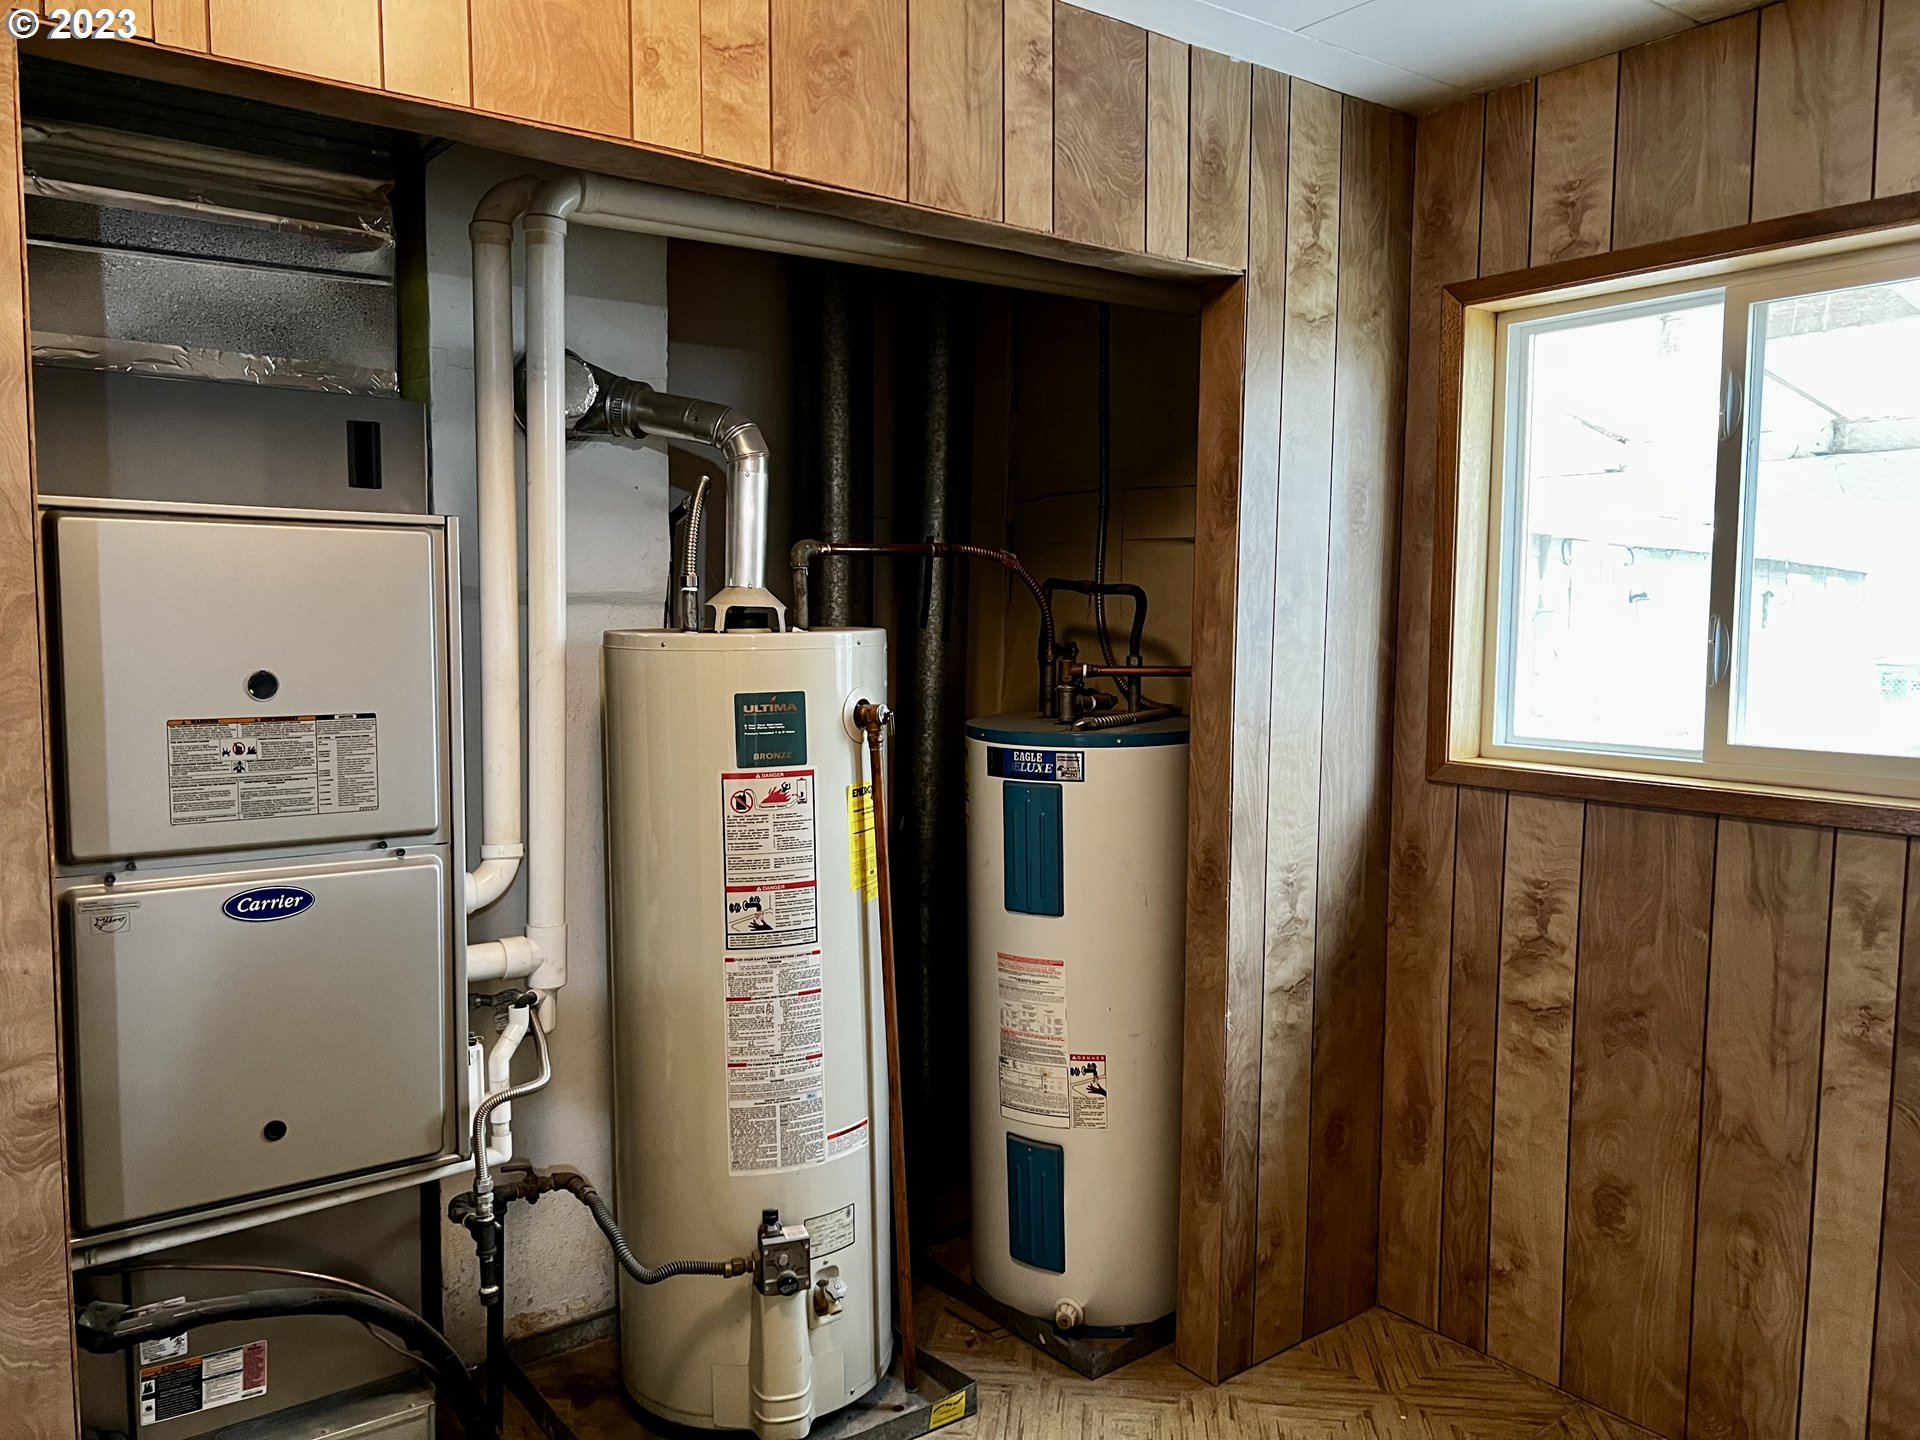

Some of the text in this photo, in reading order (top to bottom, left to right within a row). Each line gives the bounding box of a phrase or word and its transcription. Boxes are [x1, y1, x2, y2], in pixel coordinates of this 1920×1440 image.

[743, 703, 798, 713] ULTIMA
[753, 752, 792, 760] BRONZE
[1013, 751, 1043, 762] EAGLE
[237, 894, 304, 912] Carrier
